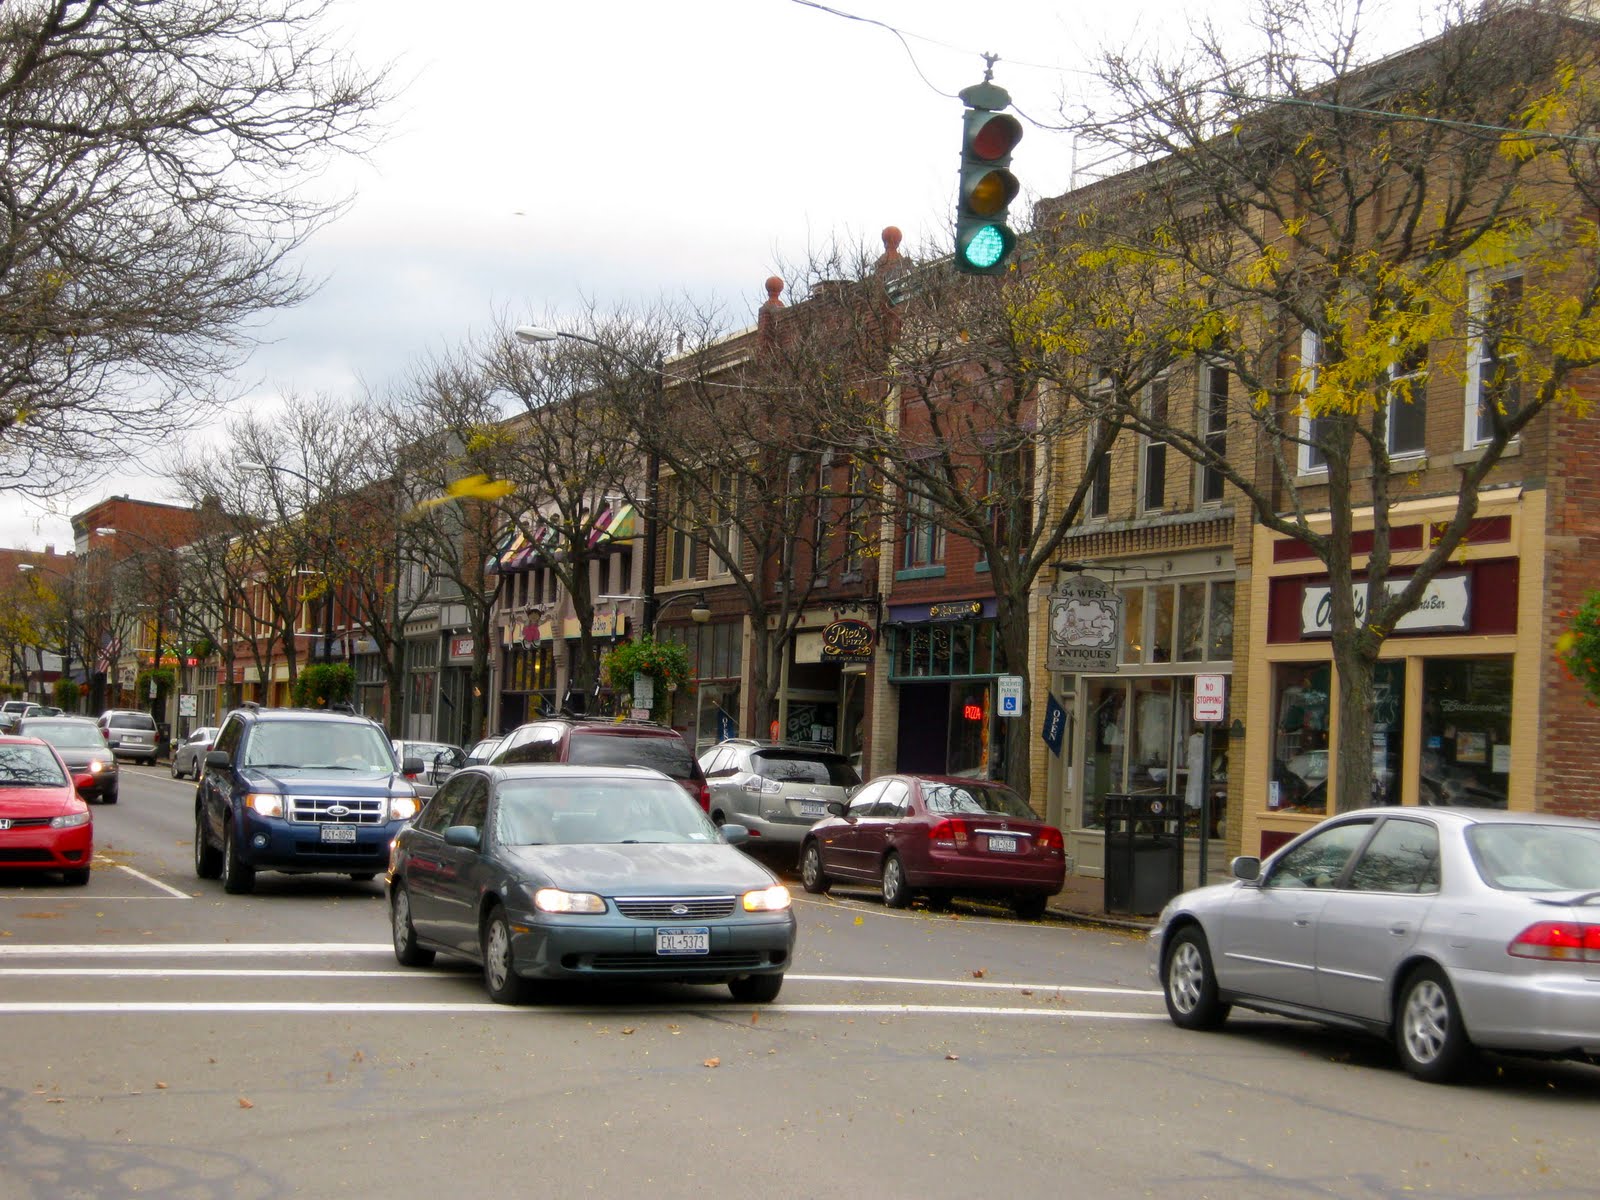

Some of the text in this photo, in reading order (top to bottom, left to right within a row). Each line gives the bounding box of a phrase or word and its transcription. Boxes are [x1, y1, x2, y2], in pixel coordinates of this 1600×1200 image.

[1061, 589, 1108, 598] 94 WEST
[829, 624, 867, 646] Rico's
[1055, 649, 1111, 659] ANTIQUES
[1205, 683, 1214, 691] NO
[1196, 696, 1223, 704] STOPPING
[964, 705, 981, 720] PIZZA
[1049, 710, 1060, 740] OPEN
